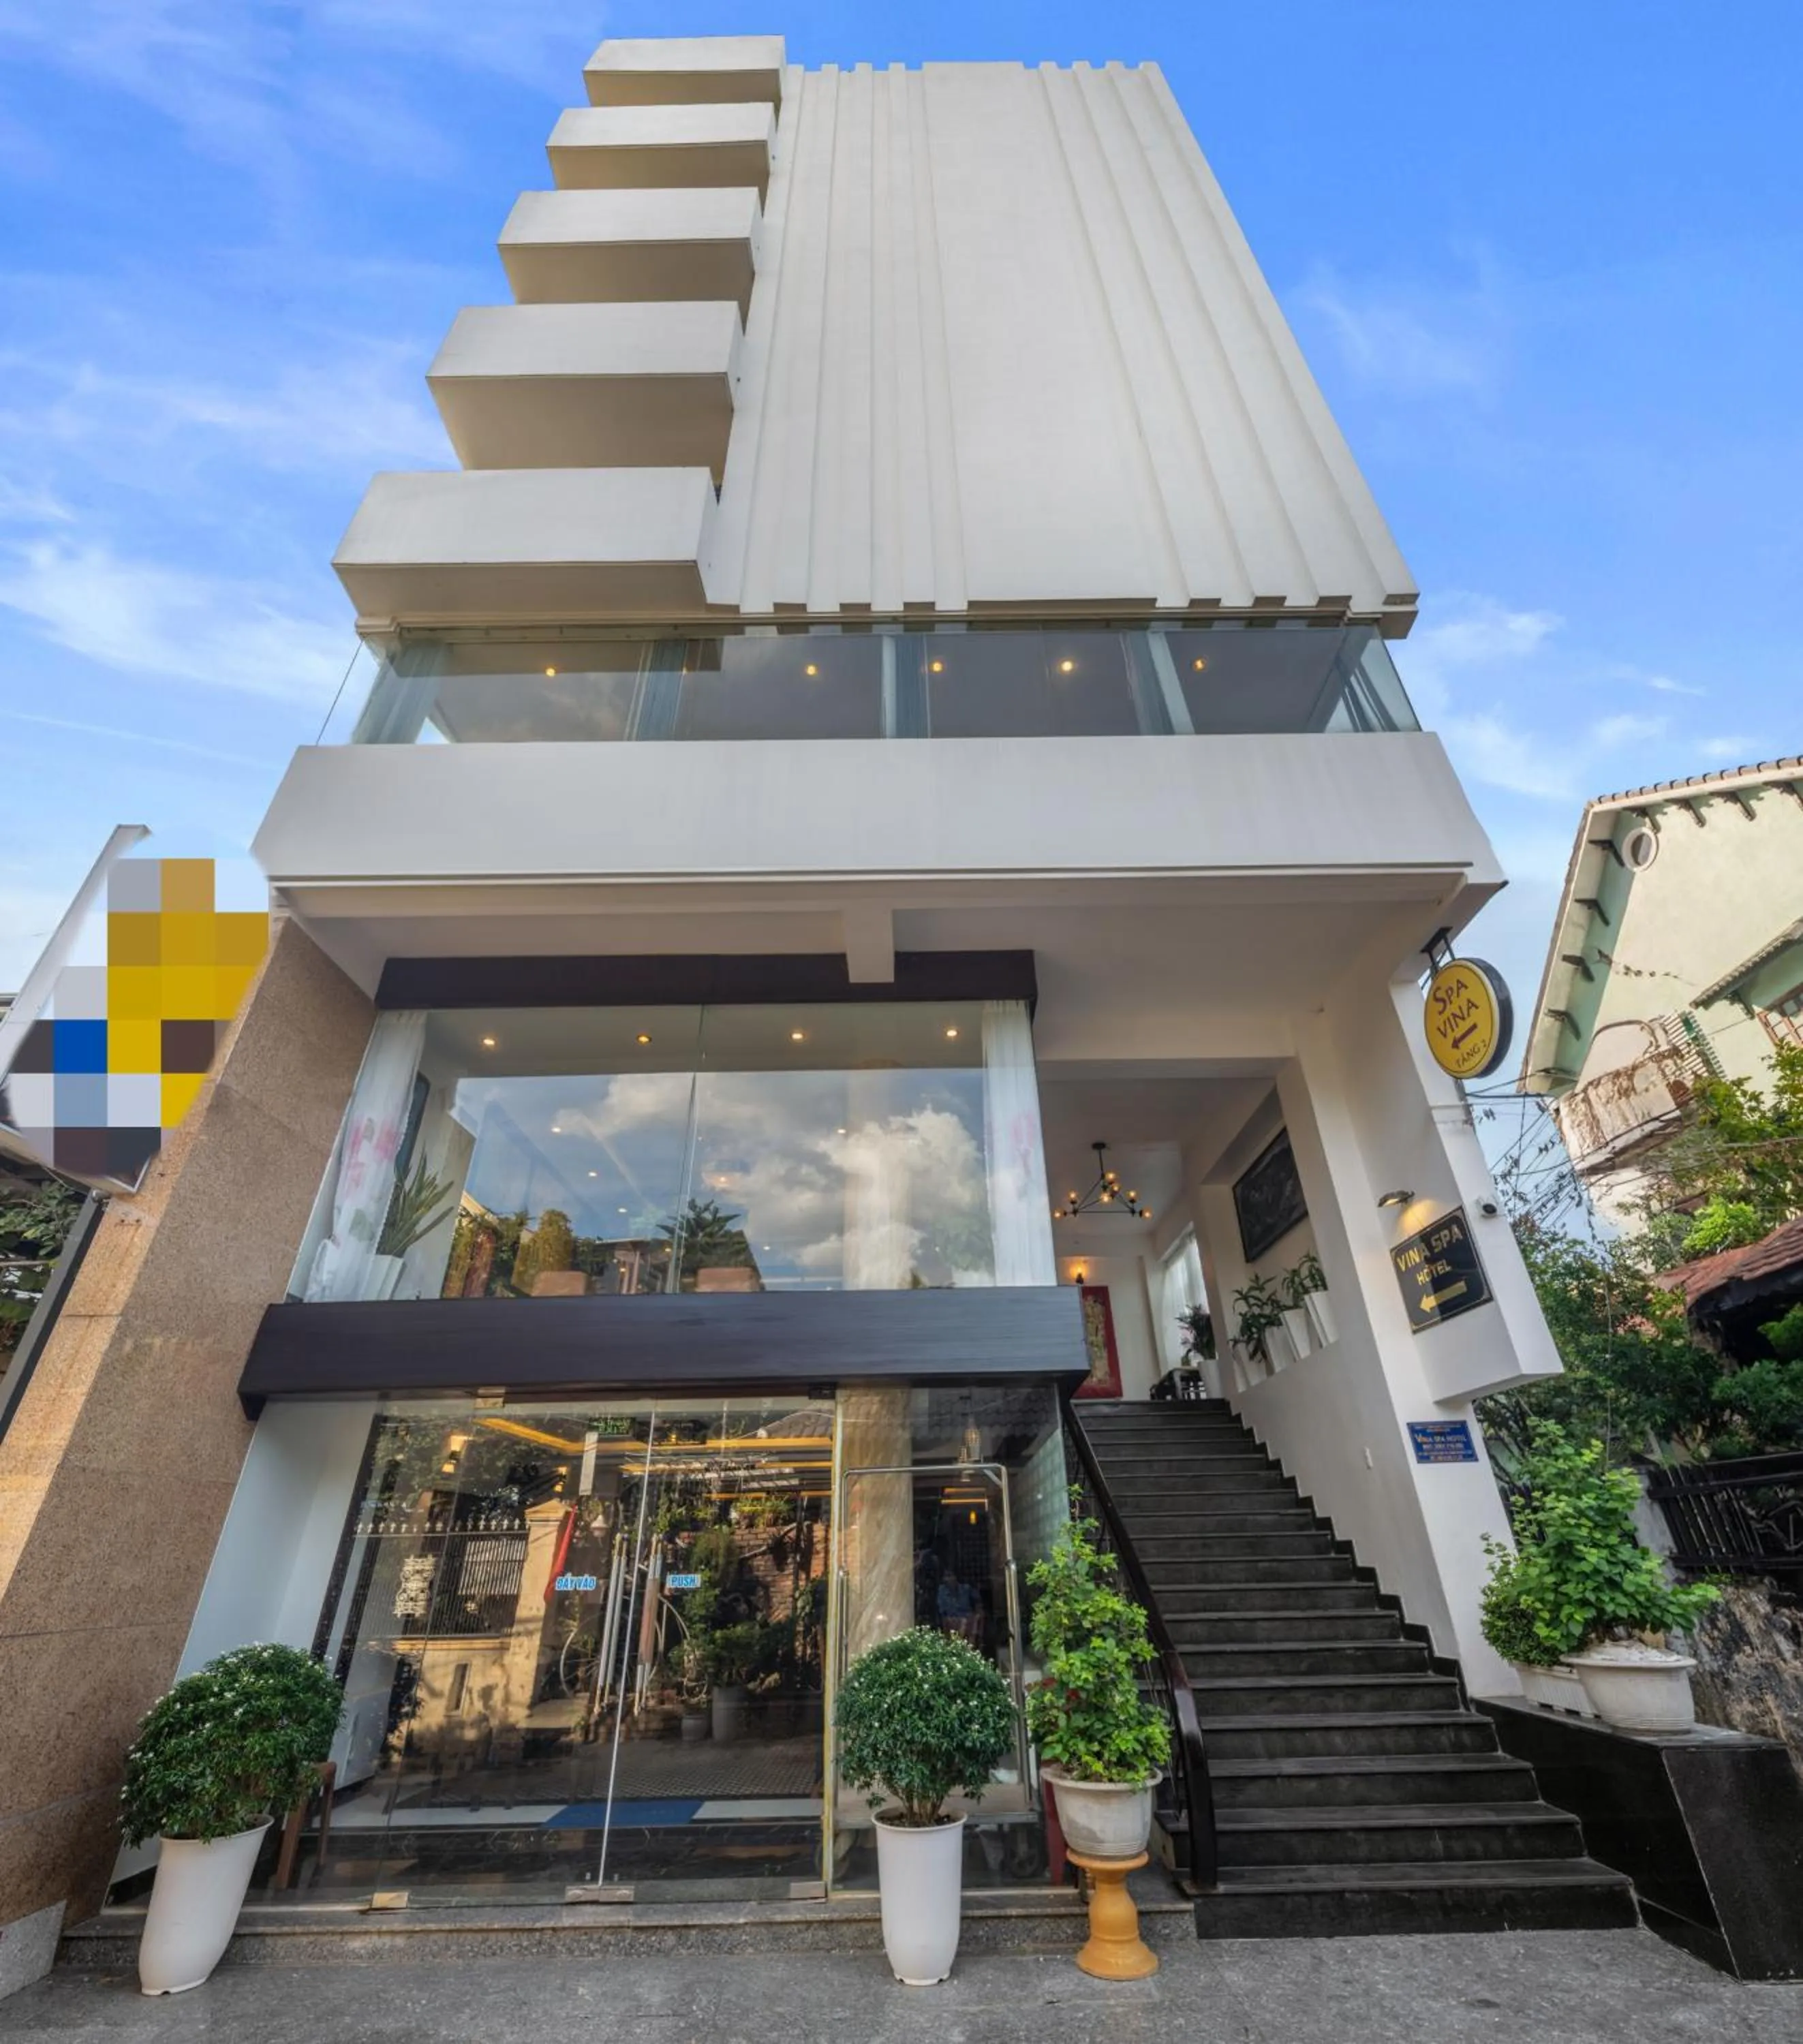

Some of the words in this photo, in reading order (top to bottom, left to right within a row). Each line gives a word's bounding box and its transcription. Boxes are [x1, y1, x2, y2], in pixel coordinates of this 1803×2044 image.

[1432, 978, 1468, 1015] SPA
[1436, 998, 1479, 1038] VINA
[1397, 1242, 1431, 1272] VINA
[1431, 1224, 1464, 1252] SPA
[671, 1575, 697, 1587] PUSH
